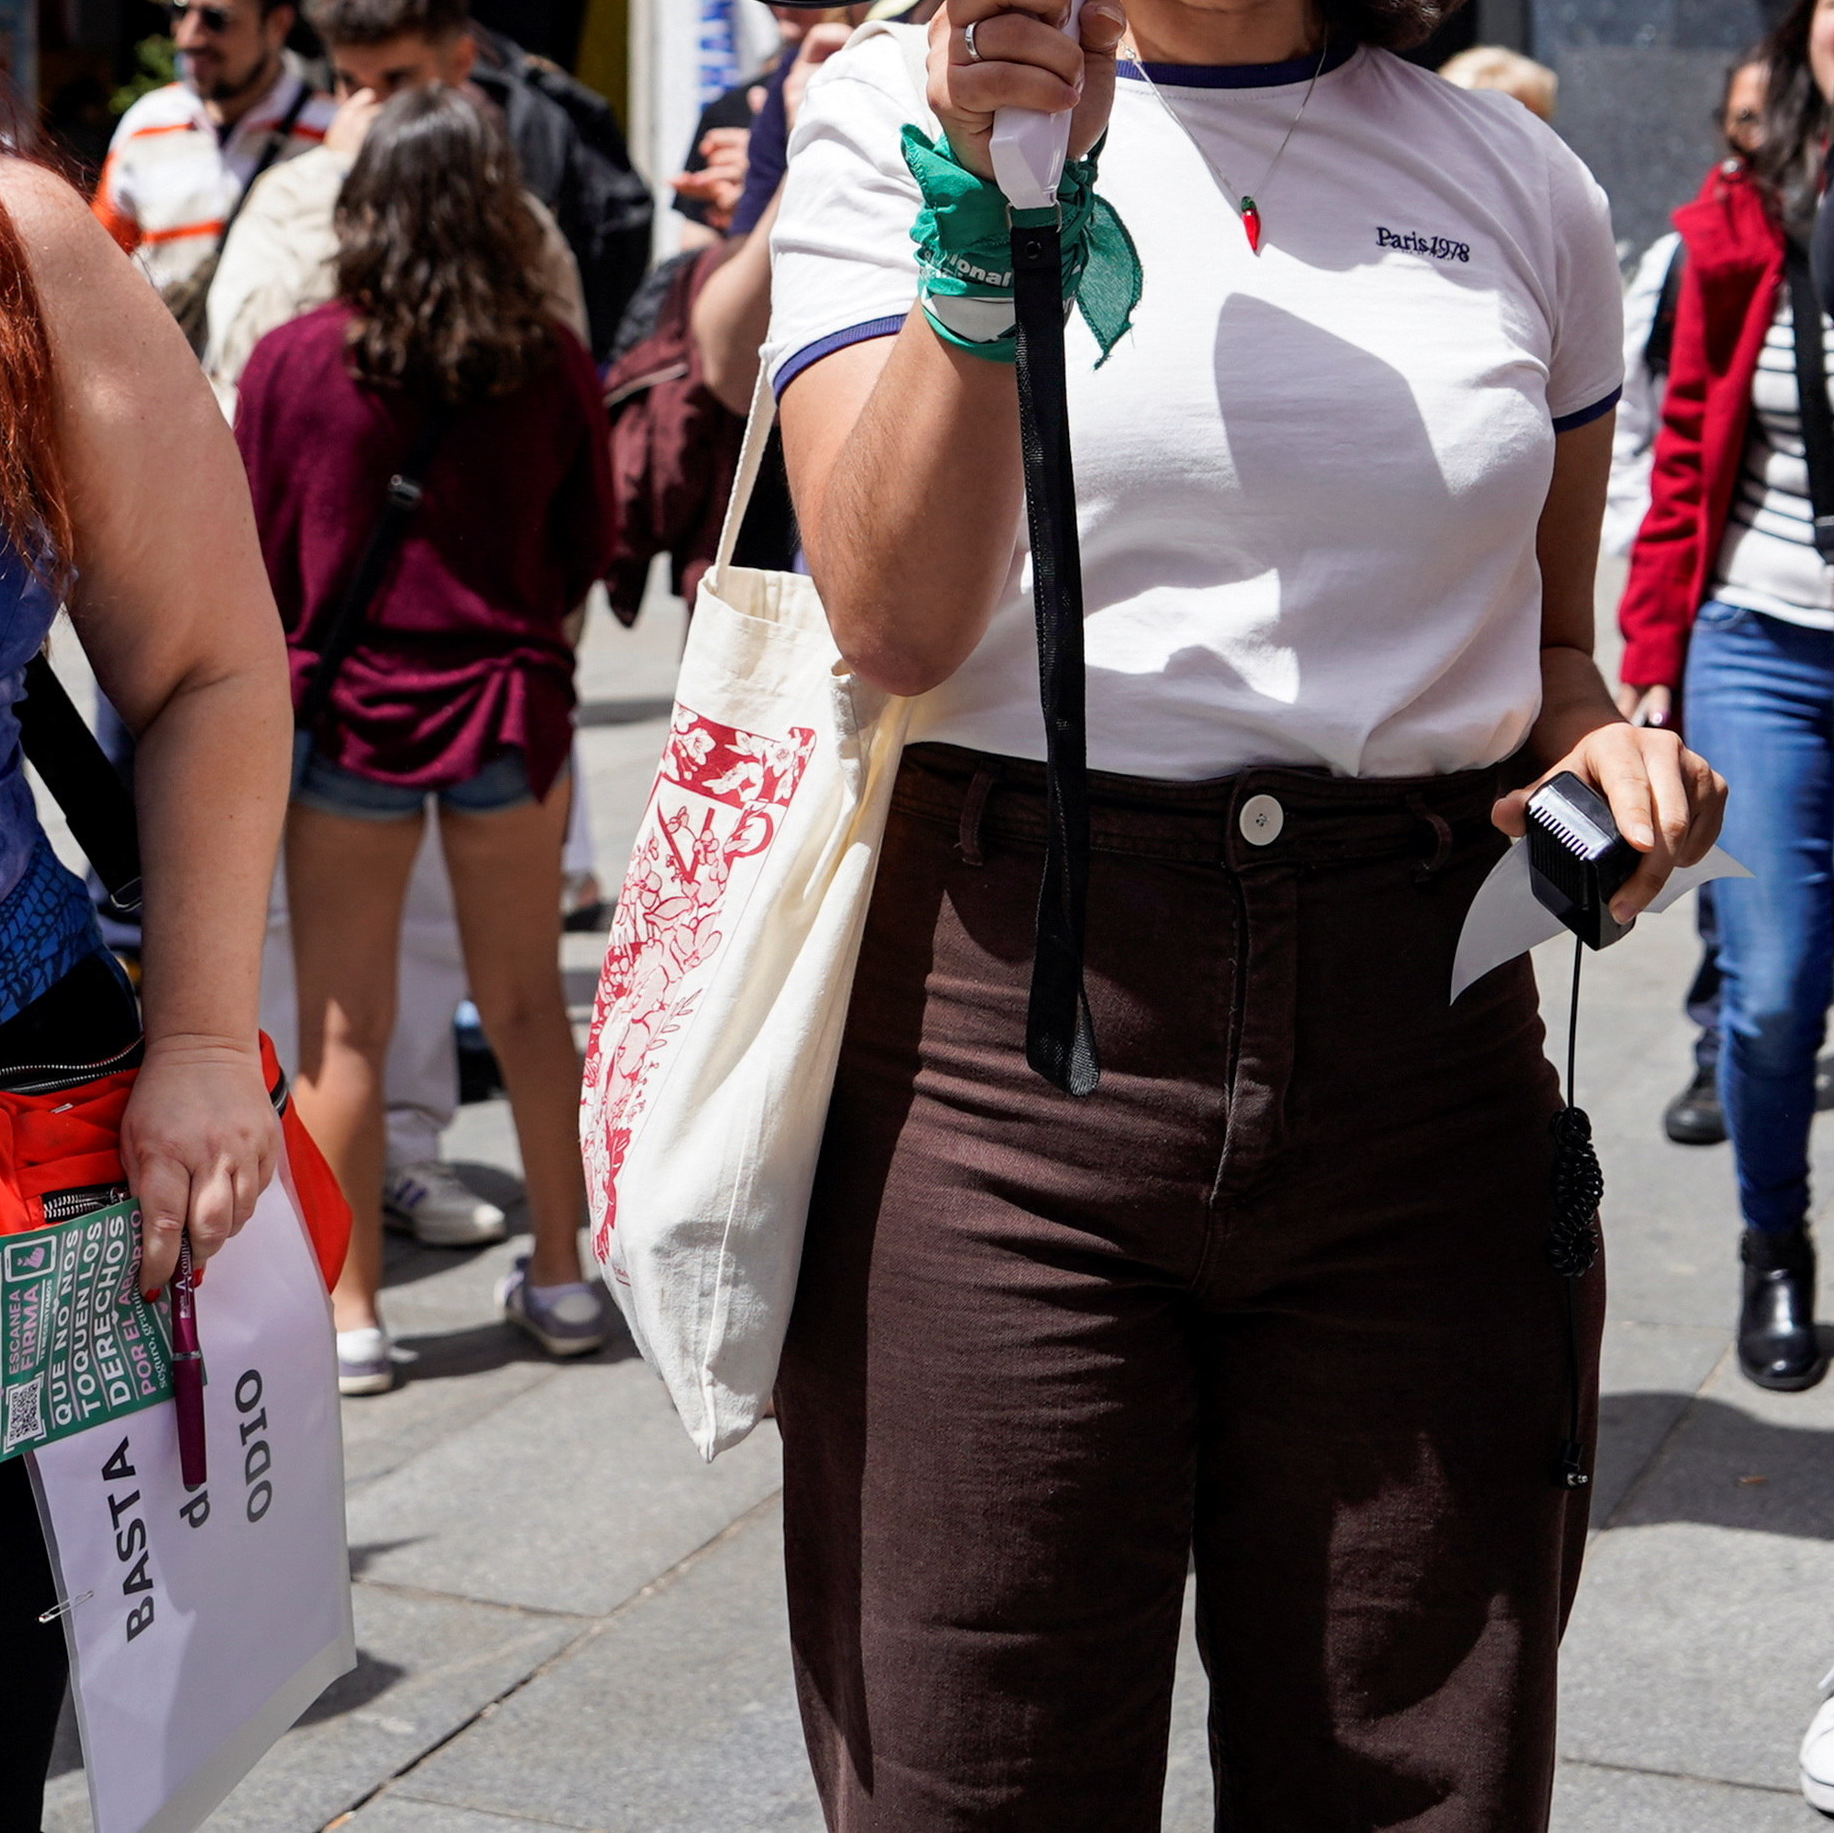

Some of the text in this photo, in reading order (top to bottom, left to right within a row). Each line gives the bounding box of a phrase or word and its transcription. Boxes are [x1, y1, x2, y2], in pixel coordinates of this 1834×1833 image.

[9, 1289, 22, 1375] ESCANEA
[21, 1284, 40, 1371] FIRMA
[41, 1279, 53, 1348] NECESITAMOS
[52, 1229, 80, 1426] QUE NO NOS
[73, 1221, 103, 1418] TOQUEN LOS
[94, 1215, 132, 1407] DERECHOS
[118, 1210, 157, 1395] POR EL ABORTO
[179, 1483, 211, 1528] d
[234, 1369, 273, 1523] ODIO
[101, 1435, 155, 1643] BASTA
